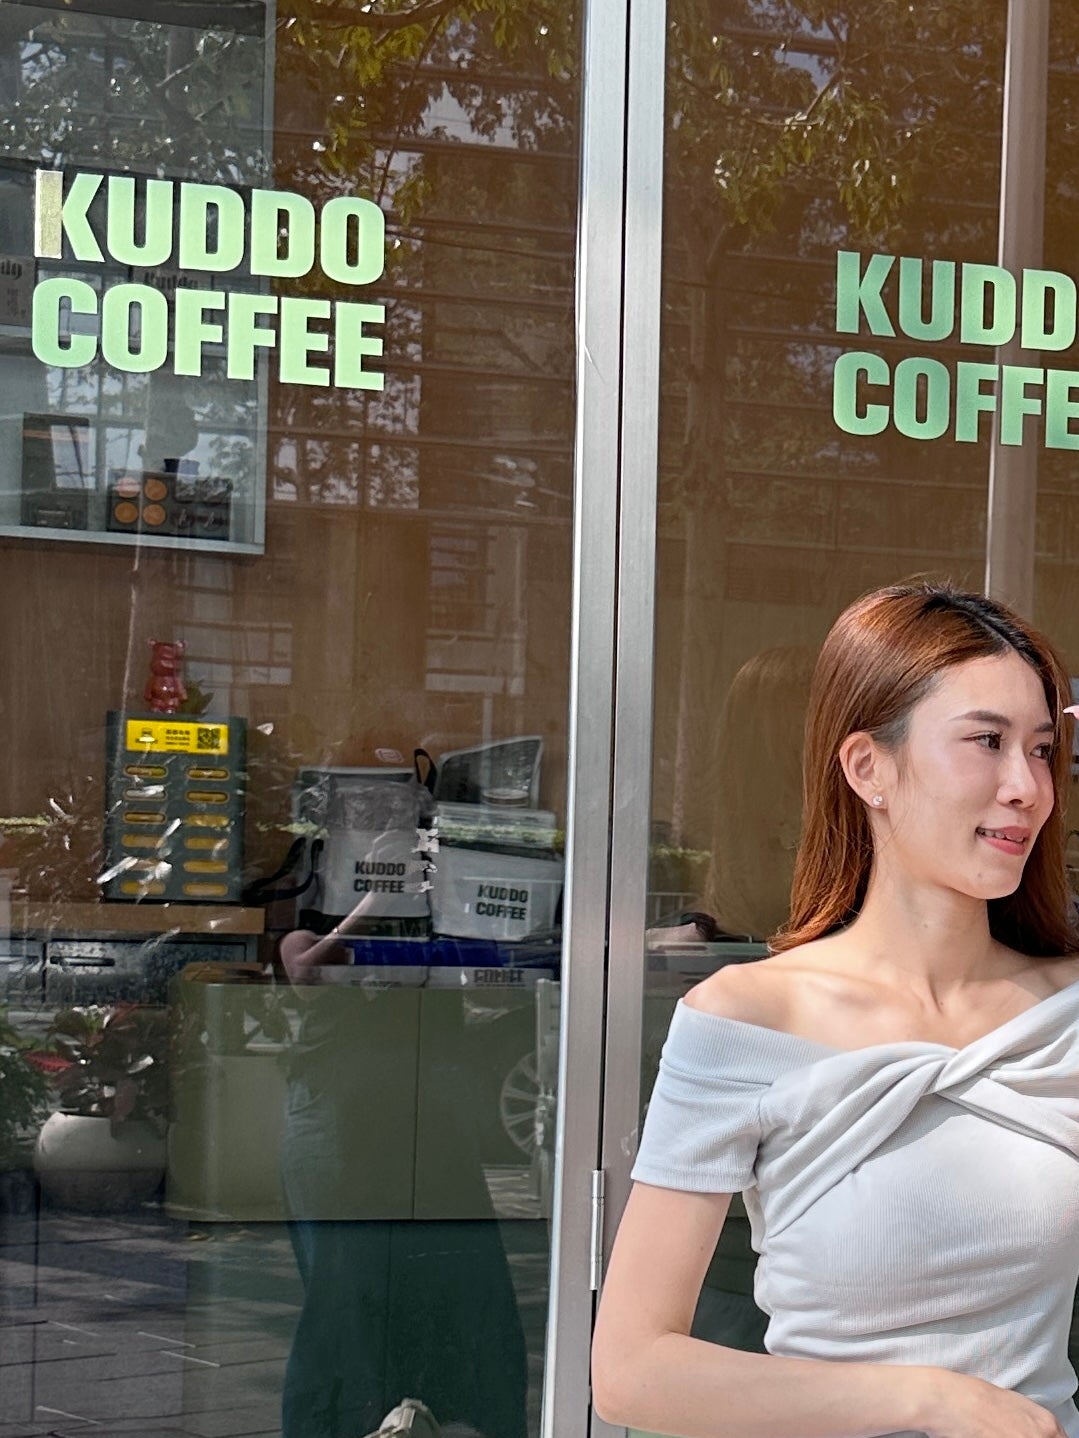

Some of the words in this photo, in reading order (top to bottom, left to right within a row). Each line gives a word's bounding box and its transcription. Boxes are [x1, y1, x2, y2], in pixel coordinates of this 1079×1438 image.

[34, 169, 386, 285] KUDDO
[31, 277, 387, 390] COFFEE
[355, 861, 406, 876] KUDDO
[354, 879, 405, 893] COFFEE
[477, 884, 528, 903] KUDDO
[476, 902, 527, 920] COFFEE
